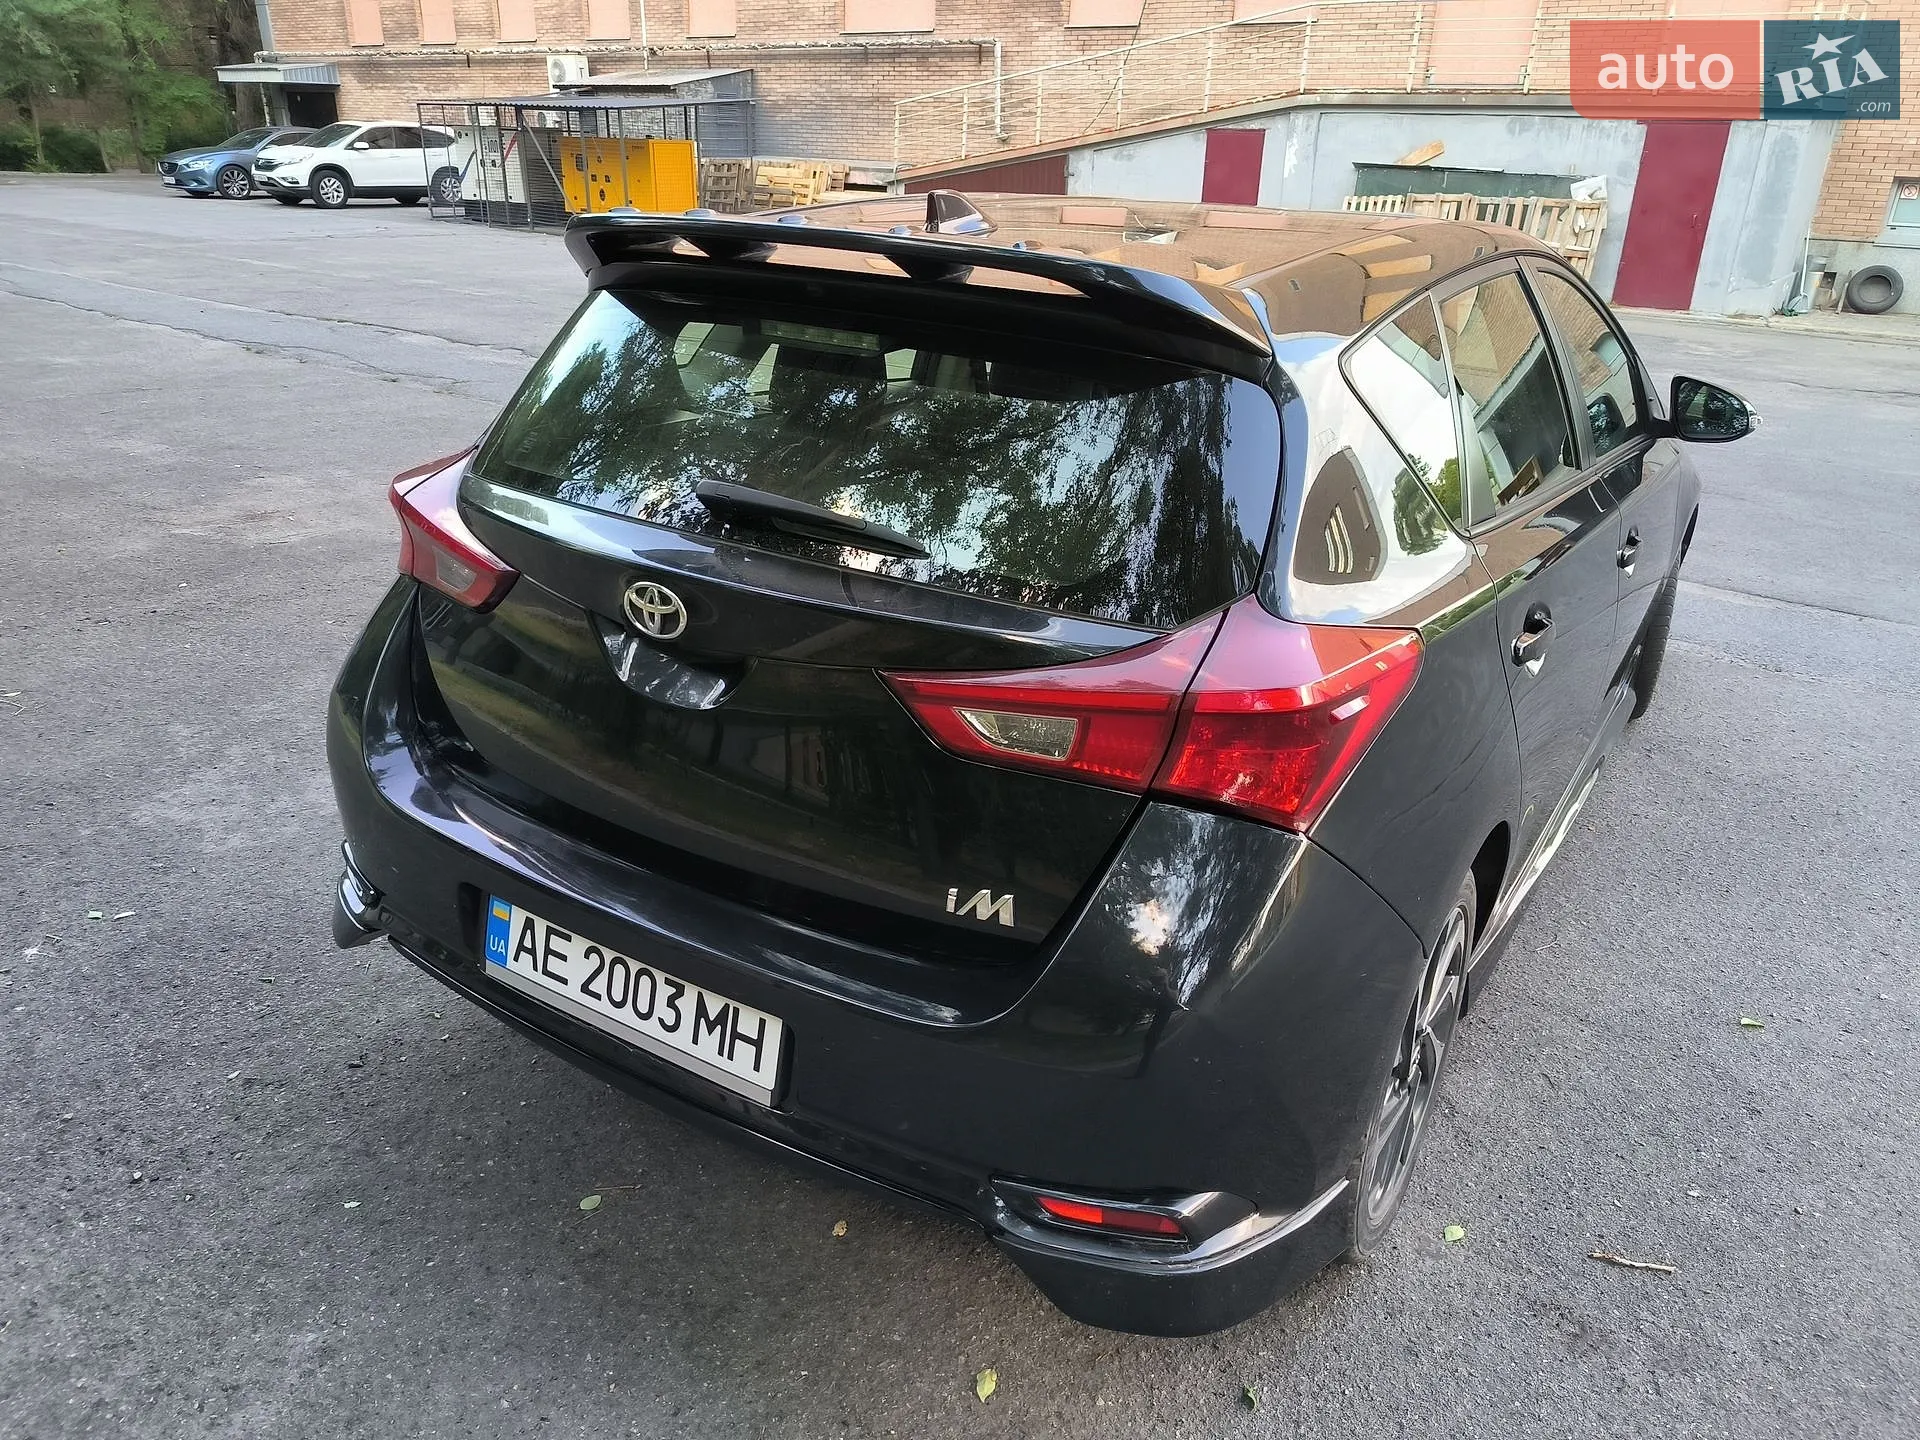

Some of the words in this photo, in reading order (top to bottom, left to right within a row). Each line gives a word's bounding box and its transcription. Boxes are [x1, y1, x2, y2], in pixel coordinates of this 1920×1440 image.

[489, 933, 507, 957] UA
[512, 915, 573, 987] AE
[580, 945, 686, 1034] 2003
[691, 990, 767, 1074] MH
